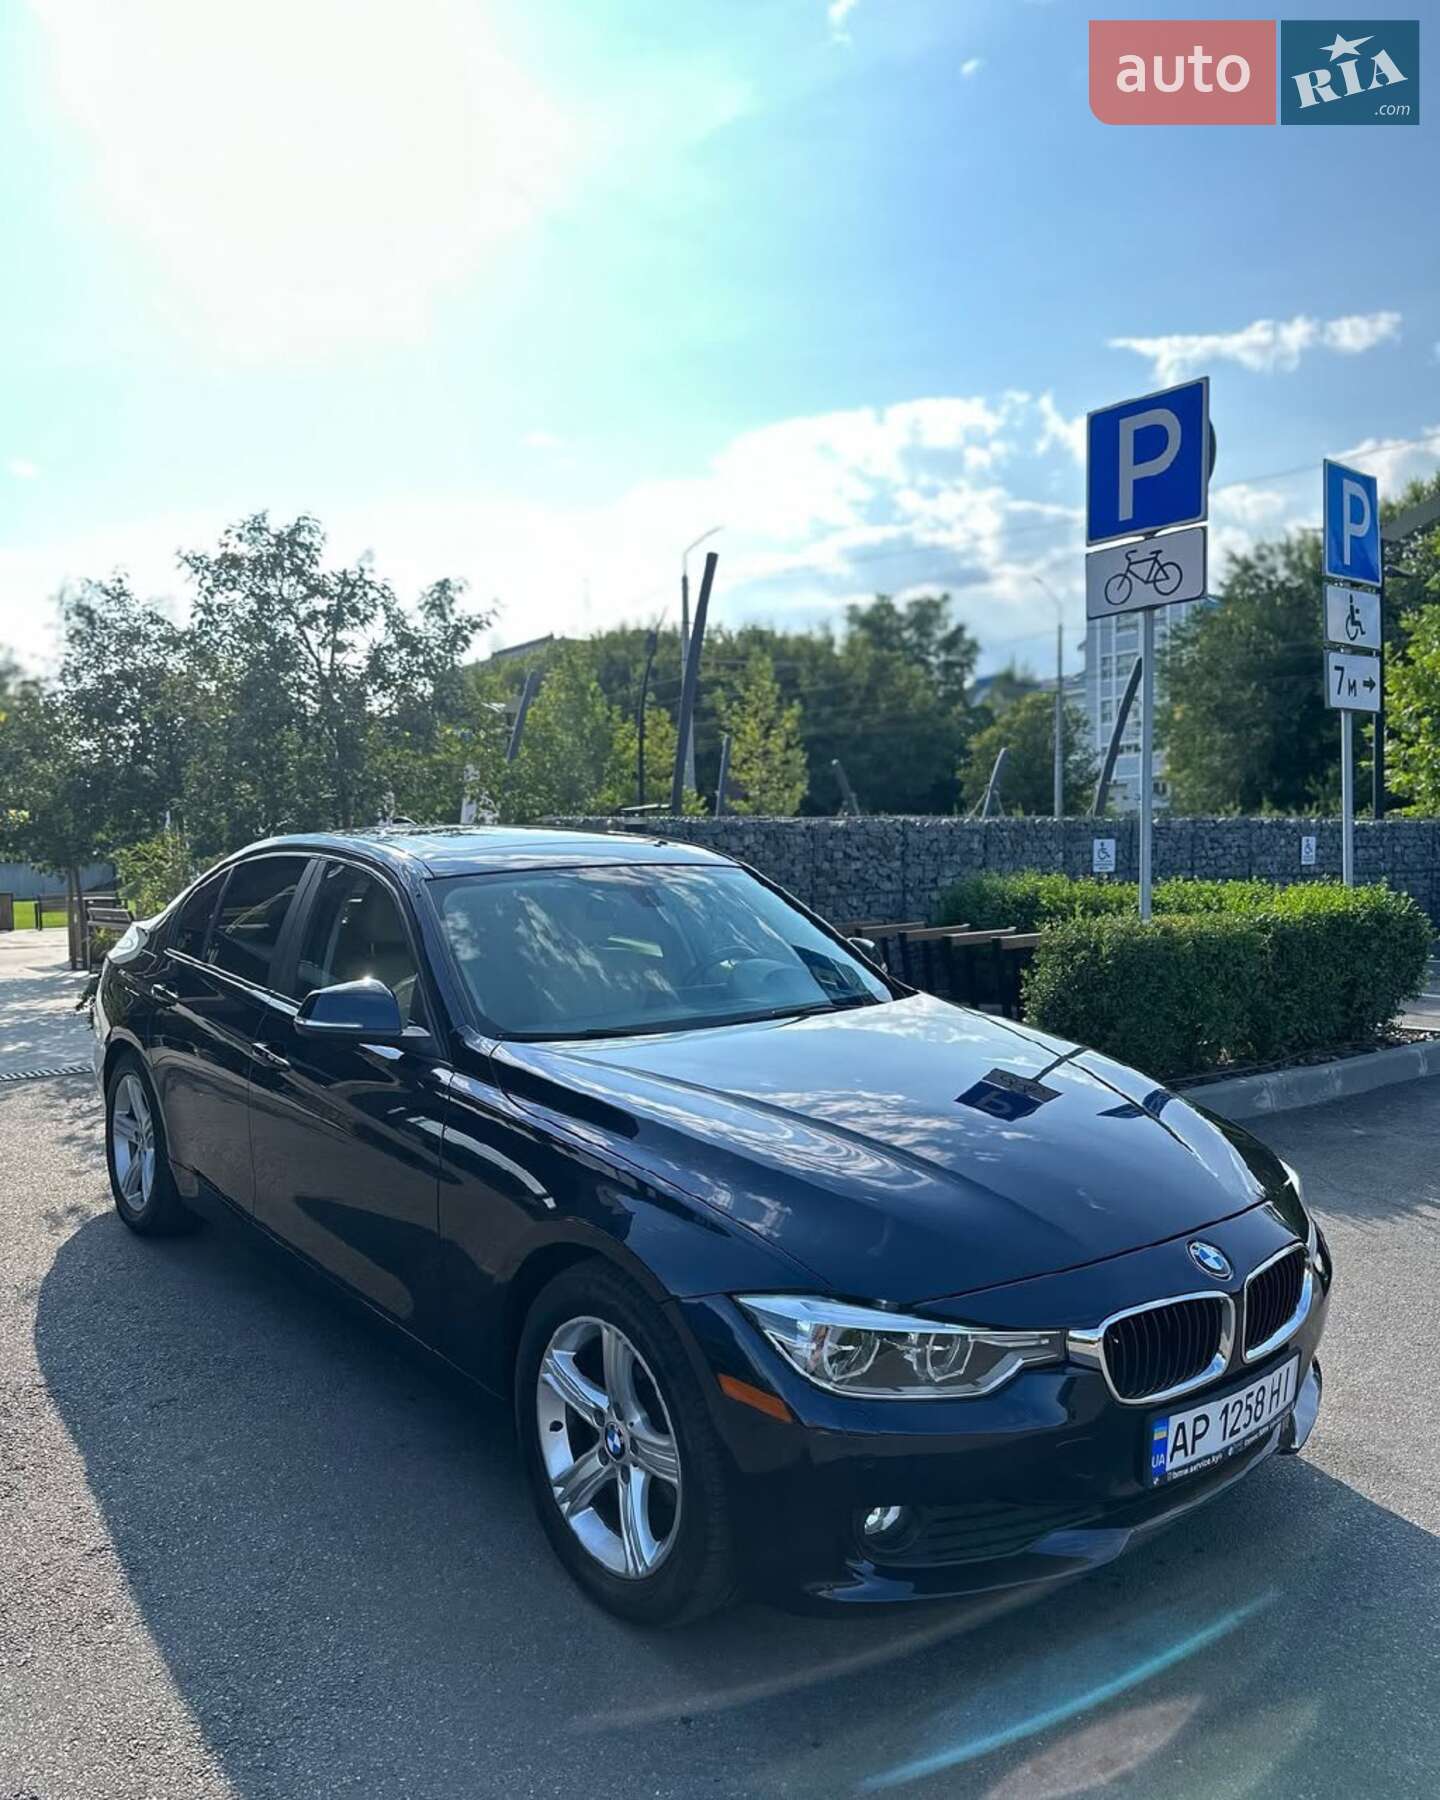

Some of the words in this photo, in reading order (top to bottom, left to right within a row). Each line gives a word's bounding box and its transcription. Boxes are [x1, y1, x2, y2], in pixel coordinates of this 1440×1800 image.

[1118, 408, 1182, 522] P
[1342, 479, 1371, 566] P
[1334, 665, 1345, 695] 7
[1169, 1413, 1210, 1463] AP
[1219, 1385, 1266, 1442] 1258
[1268, 1367, 1290, 1414] HI
[1151, 1453, 1166, 1468] UA
